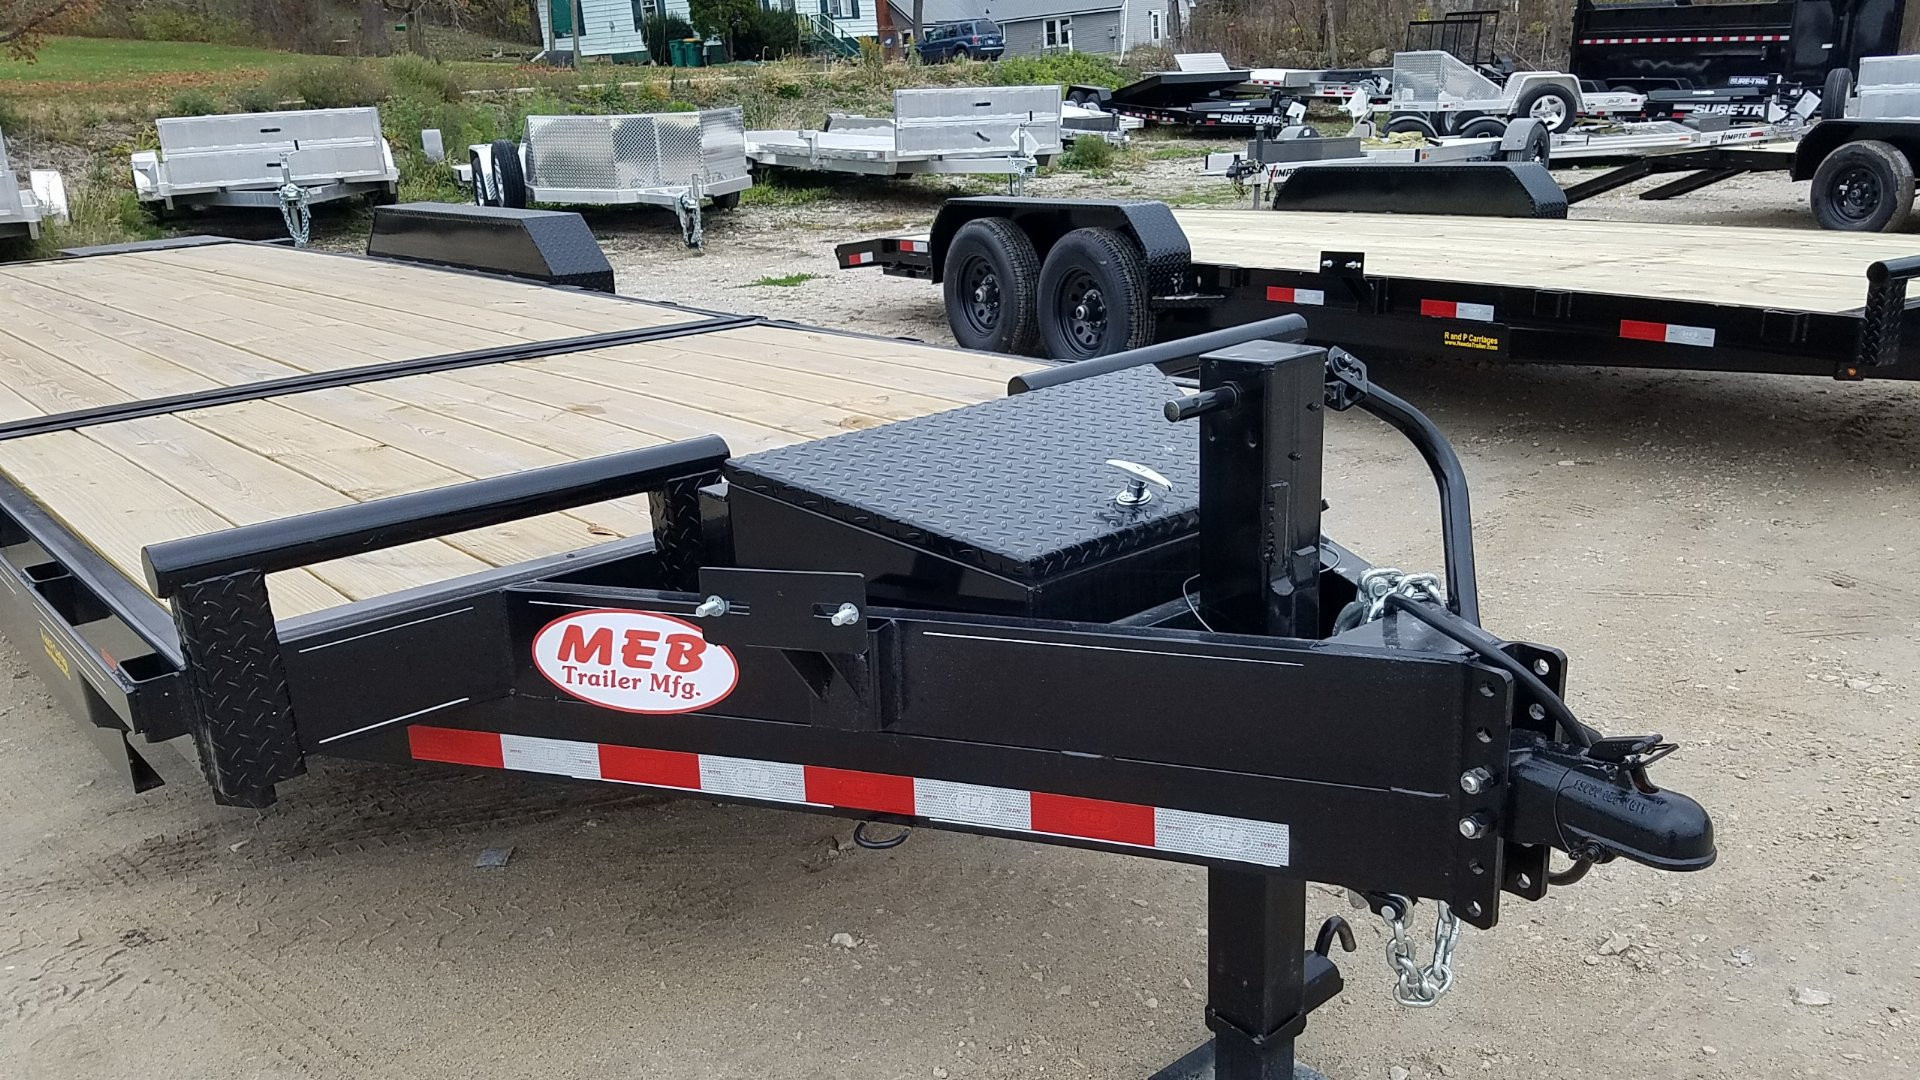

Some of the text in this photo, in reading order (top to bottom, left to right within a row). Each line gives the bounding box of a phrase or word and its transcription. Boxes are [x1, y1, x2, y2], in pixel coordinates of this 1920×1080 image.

[1450, 333, 1463, 341] and
[1463, 333, 1468, 341] P
[1468, 334, 1498, 346] Carriages
[557, 624, 707, 673] MEB
[561, 665, 701, 700] Trailer Mfg.
